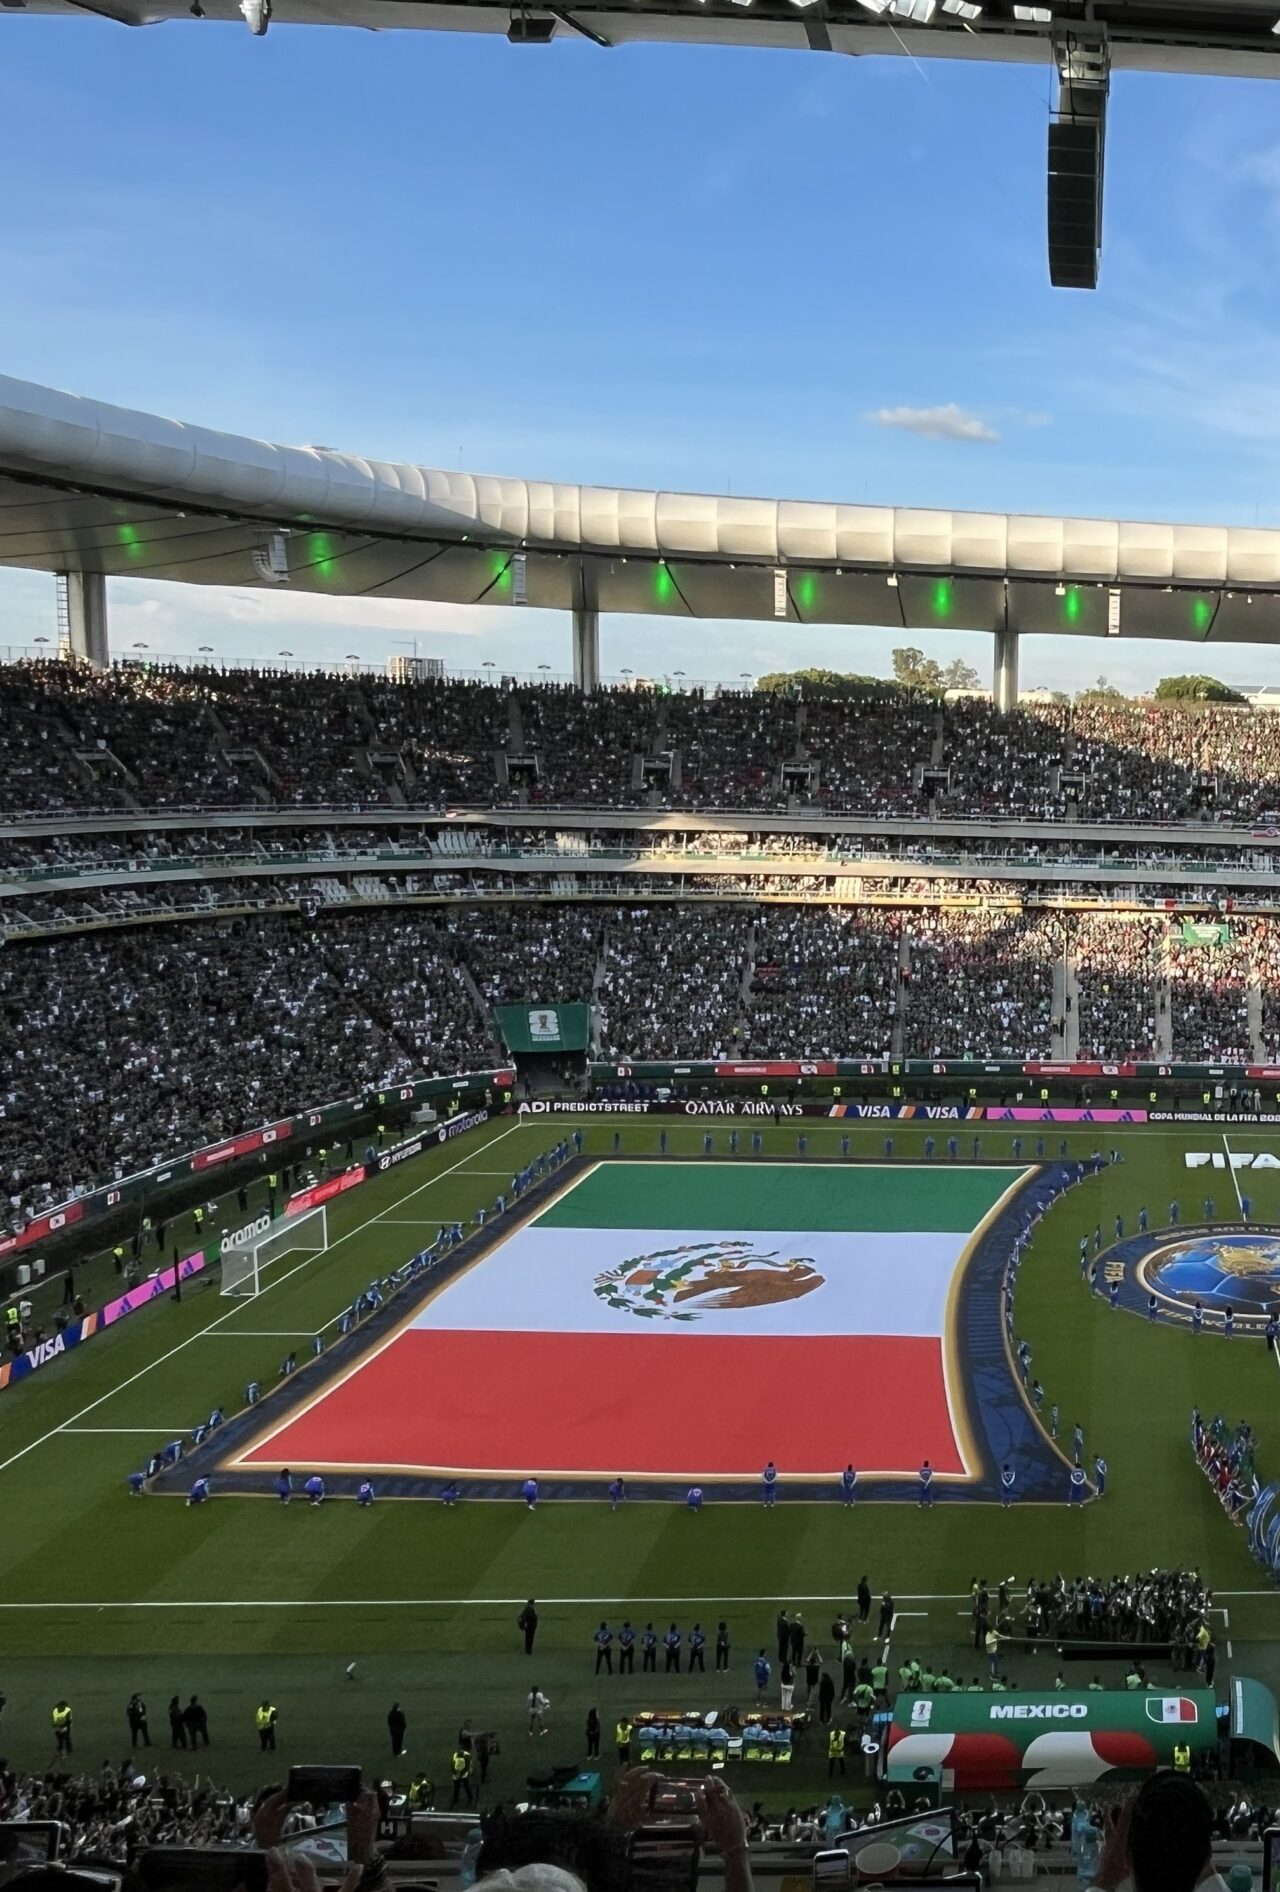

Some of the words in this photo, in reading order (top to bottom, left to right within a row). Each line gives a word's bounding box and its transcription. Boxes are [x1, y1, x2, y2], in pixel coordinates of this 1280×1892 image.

[517, 1102, 551, 1114] ADI
[553, 1102, 650, 1113] PREDICTSTREET
[684, 1100, 735, 1116] QATAR
[741, 1101, 804, 1116] AIRWAYS
[856, 1104, 891, 1118] VISA
[925, 1106, 960, 1119] VISA
[1149, 1112, 1173, 1120] COPA
[220, 1215, 271, 1254] aramco
[26, 1333, 66, 1369] VISA
[989, 1704, 1089, 1719] MEXICO
